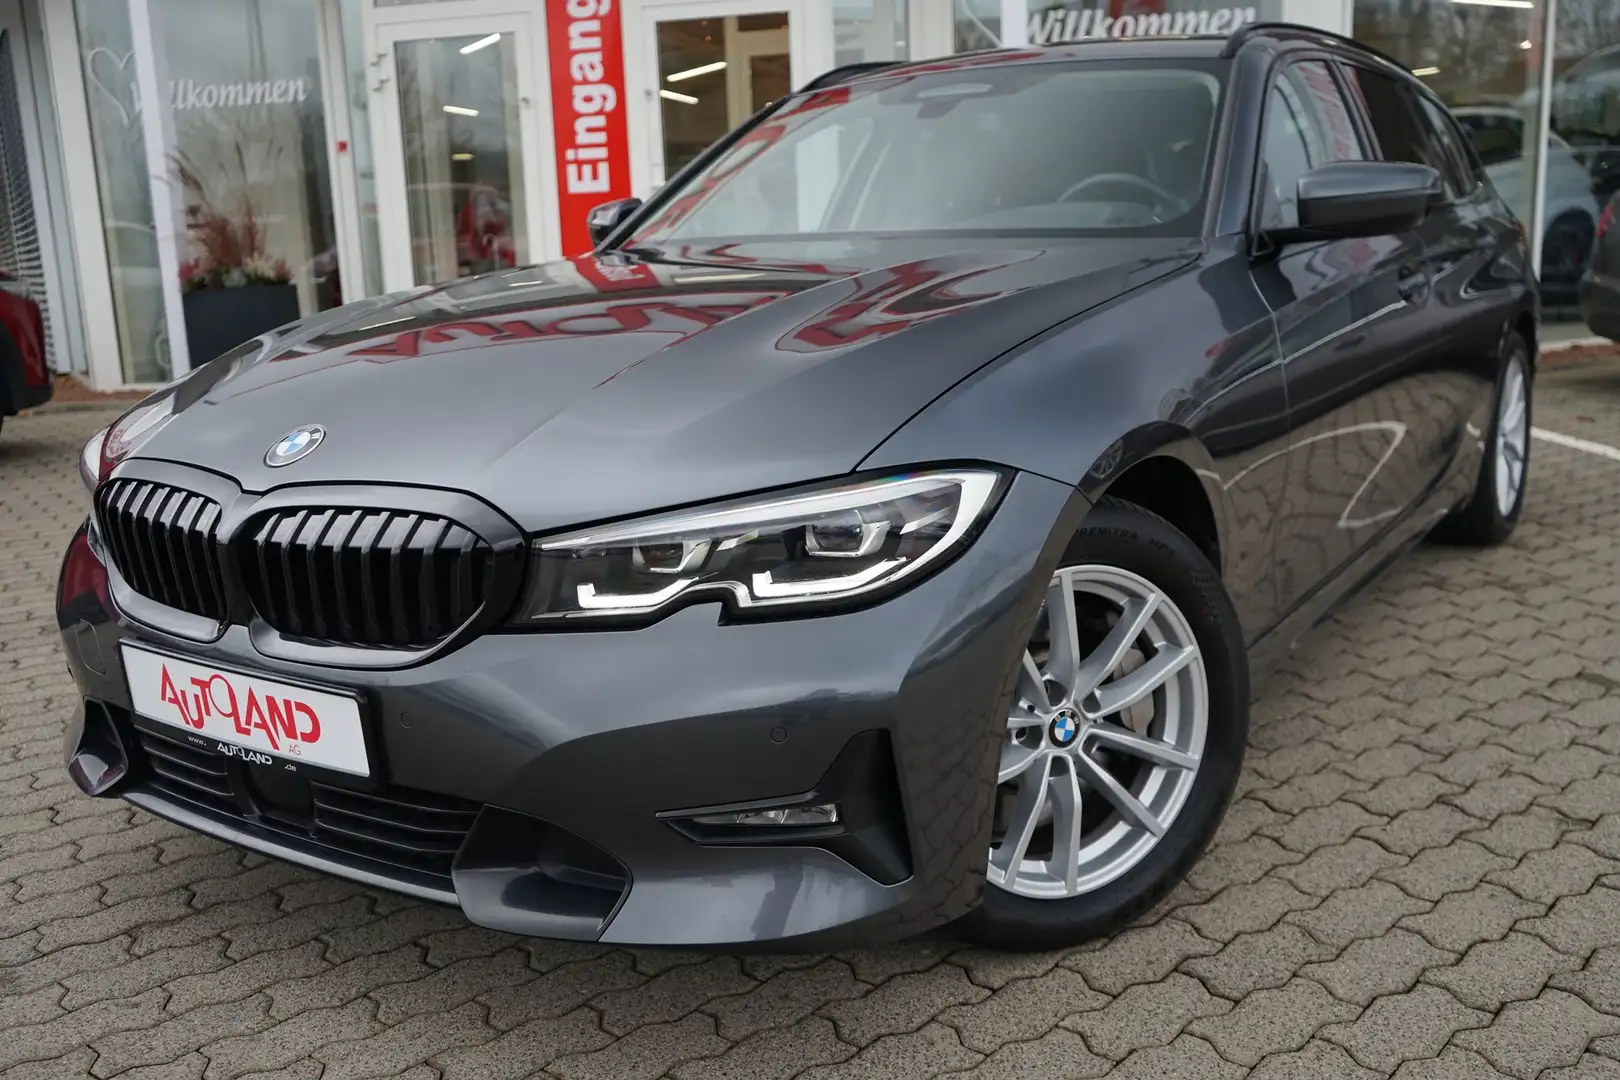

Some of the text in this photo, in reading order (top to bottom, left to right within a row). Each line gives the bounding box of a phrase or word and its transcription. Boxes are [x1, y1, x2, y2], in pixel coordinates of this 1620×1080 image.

[1027, 7, 1257, 45] Willkommen
[129, 76, 307, 113] Wlkommen
[565, 0, 617, 195] Eingang
[160, 663, 321, 751] AUTOLAND
[217, 742, 273, 765] AUTOLAND
[288, 744, 301, 756] AG
